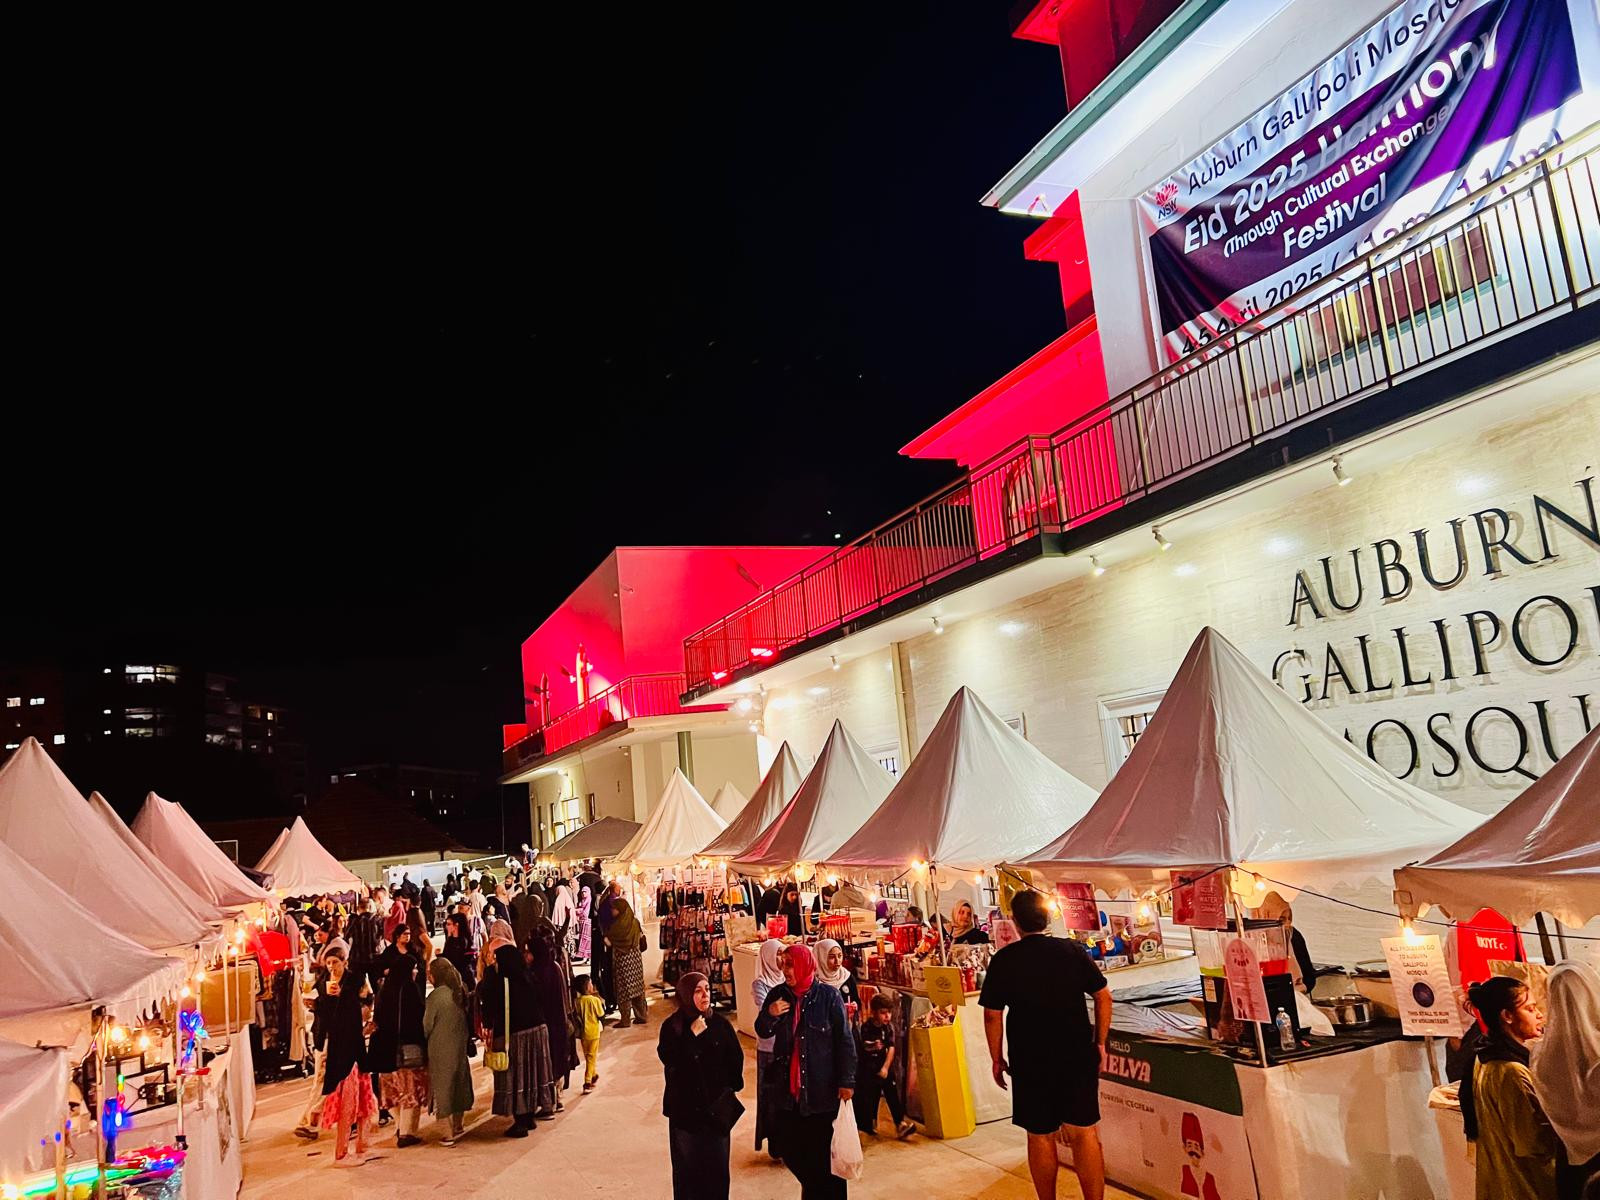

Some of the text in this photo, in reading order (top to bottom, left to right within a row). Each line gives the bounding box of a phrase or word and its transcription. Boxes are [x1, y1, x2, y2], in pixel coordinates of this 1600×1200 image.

[1188, 136, 1259, 196] Auburn
[1262, 51, 1363, 142] Gallipoli
[1157, 197, 1178, 220] NSW
[1184, 203, 1229, 255] Eid
[1230, 150, 1309, 226] 2025
[1223, 209, 1284, 259] (Through
[1284, 163, 1351, 217] Cultural
[1283, 172, 1388, 258] Festival
[1265, 262, 1324, 309] 2025
[1286, 476, 1600, 627] AUBURN
[1343, 693, 1592, 782] OSQU
[1109, 1039, 1132, 1054] HELLO
